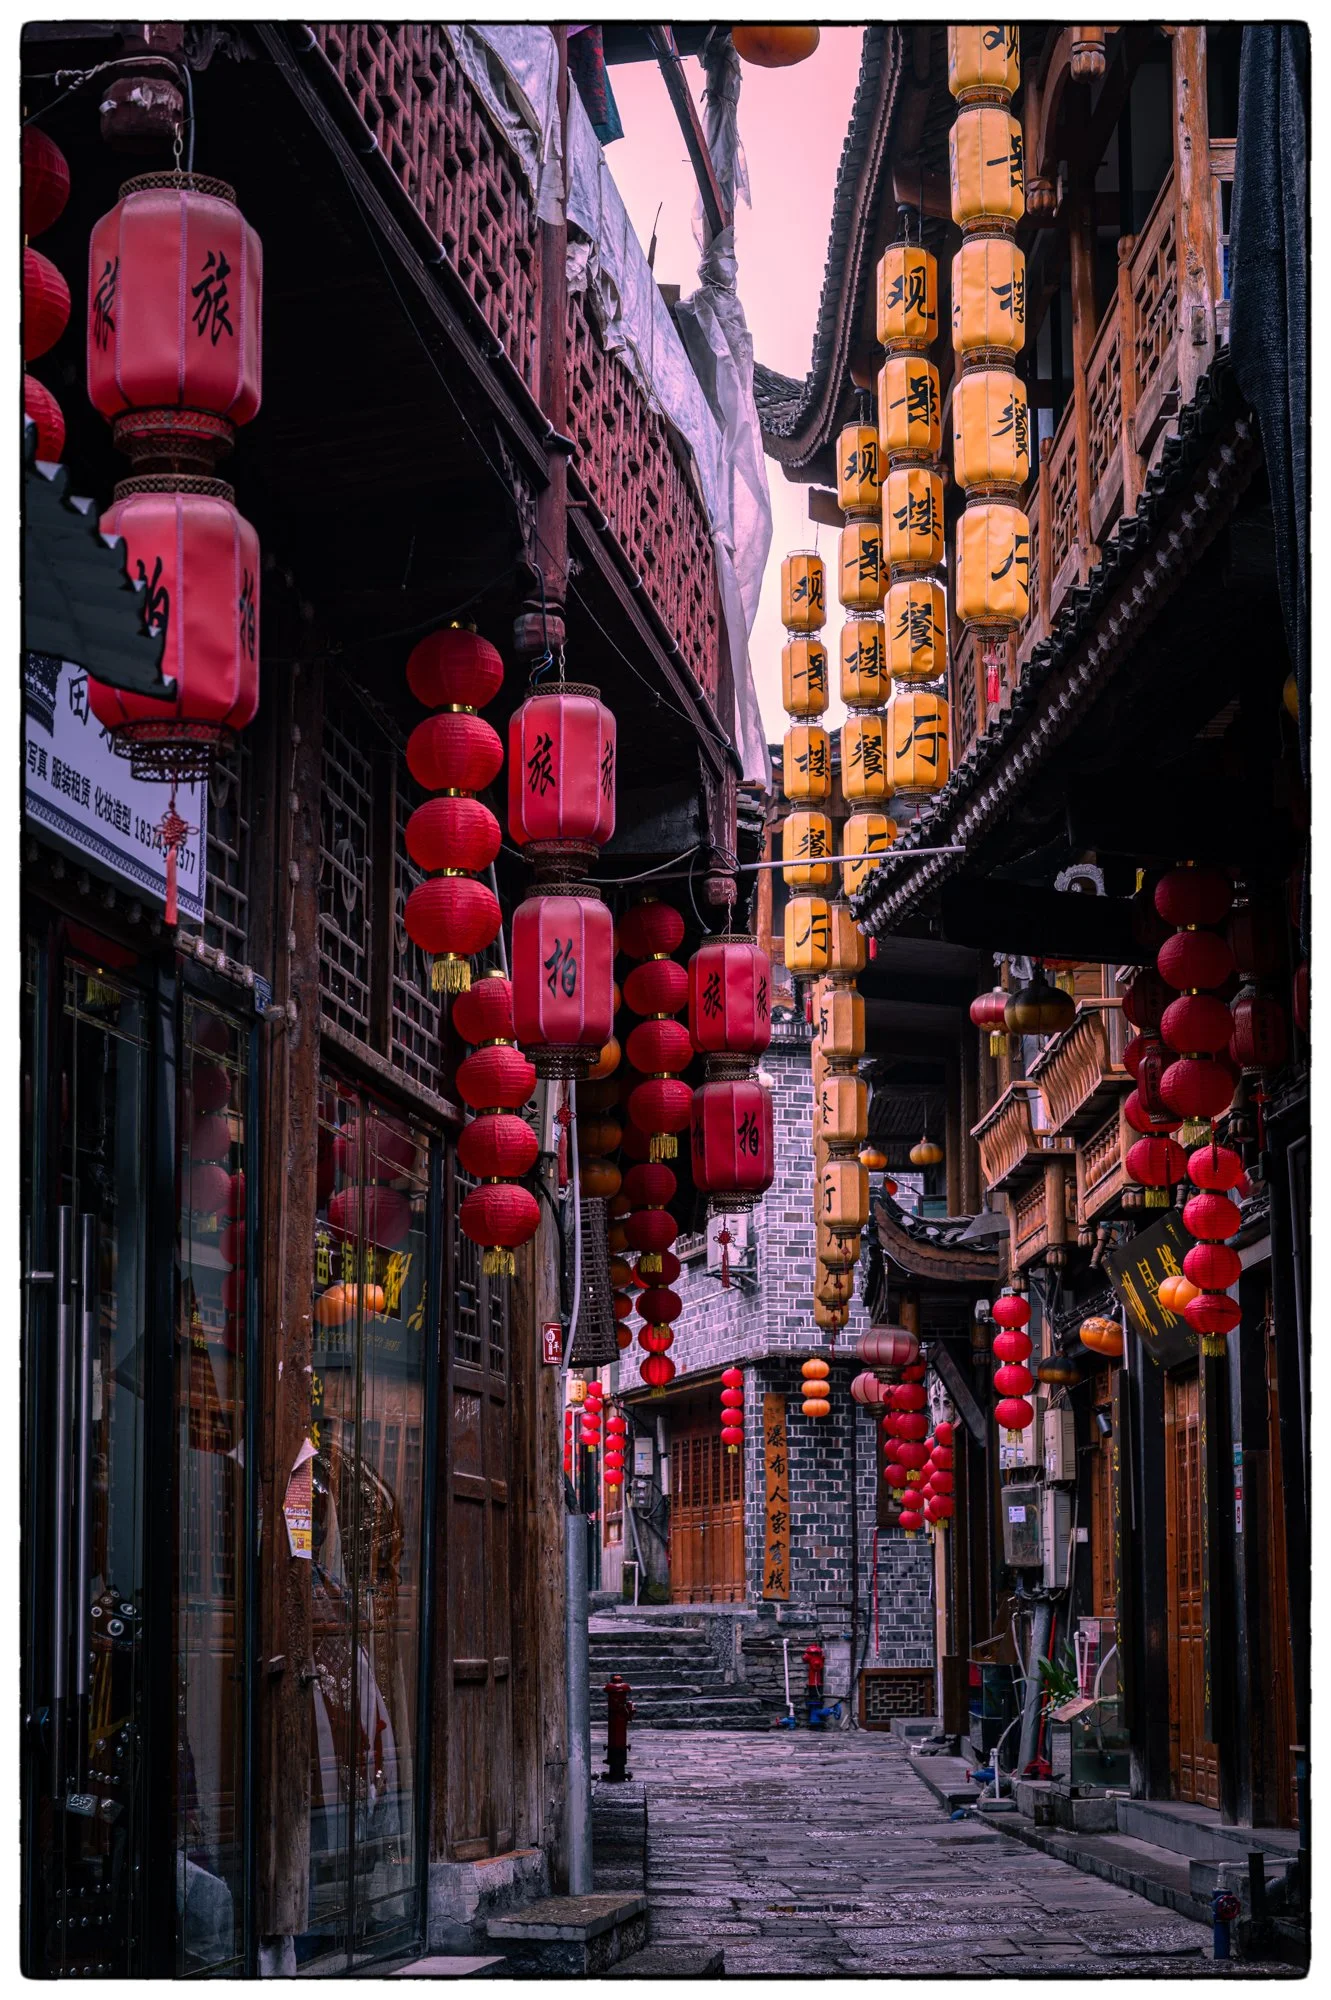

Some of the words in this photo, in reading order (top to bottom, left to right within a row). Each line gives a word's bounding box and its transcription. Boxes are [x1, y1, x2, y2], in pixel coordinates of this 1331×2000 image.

[192, 249, 234, 347] 旅
[51, 756, 91, 809] 服装租赁
[94, 785, 132, 836] 化妆造型
[527, 732, 556, 798] 旅
[544, 938, 578, 999] 拍
[703, 972, 724, 1021] 旅
[737, 1111, 759, 1157] 拍
